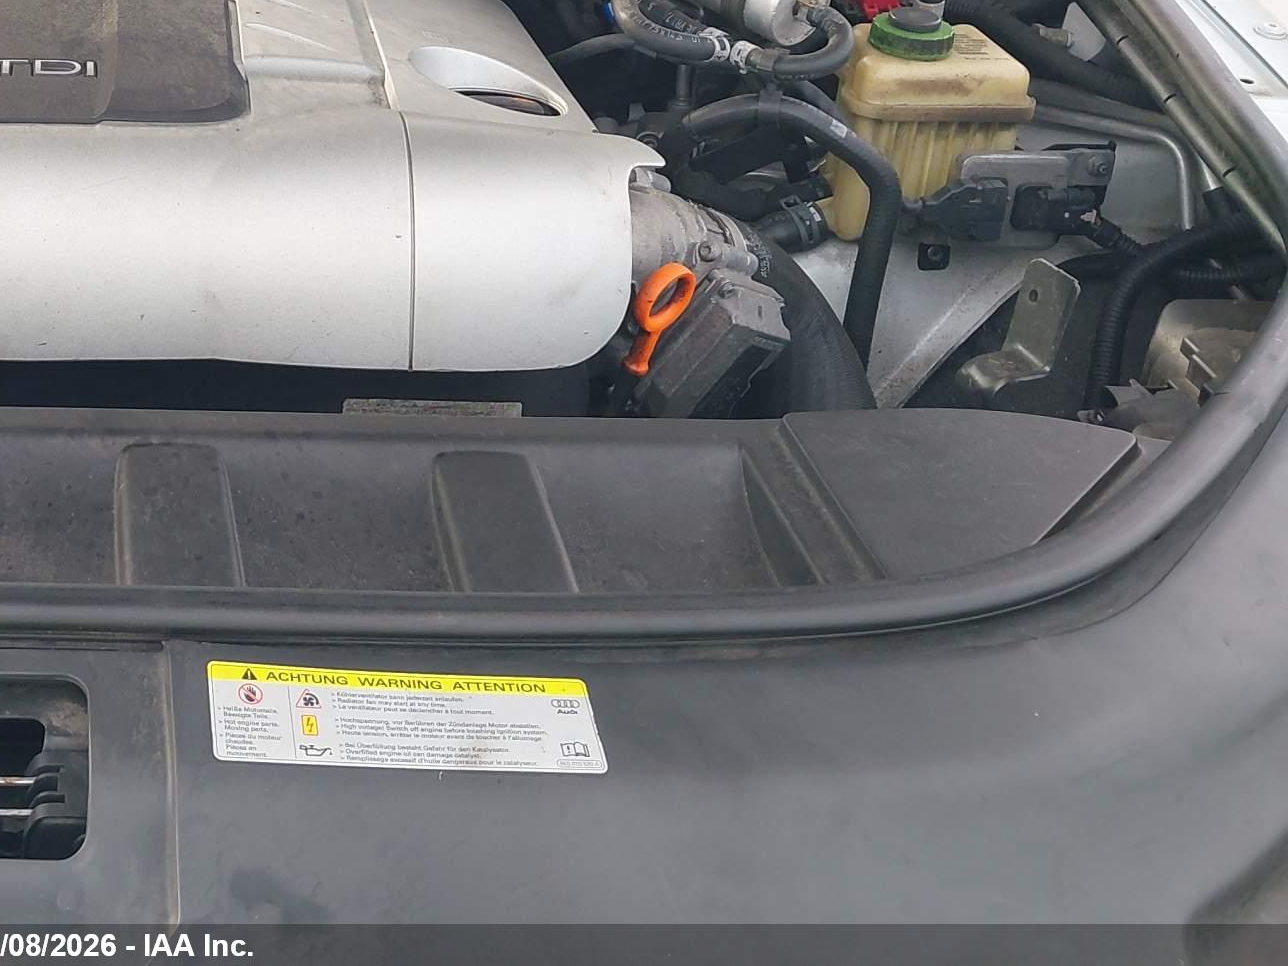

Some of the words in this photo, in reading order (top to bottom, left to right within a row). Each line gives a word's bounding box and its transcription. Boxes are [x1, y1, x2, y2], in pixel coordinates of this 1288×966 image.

[265, 671, 348, 684] ACHTUNG
[356, 676, 442, 689] WARNING
[451, 680, 546, 694] ATTENTION
